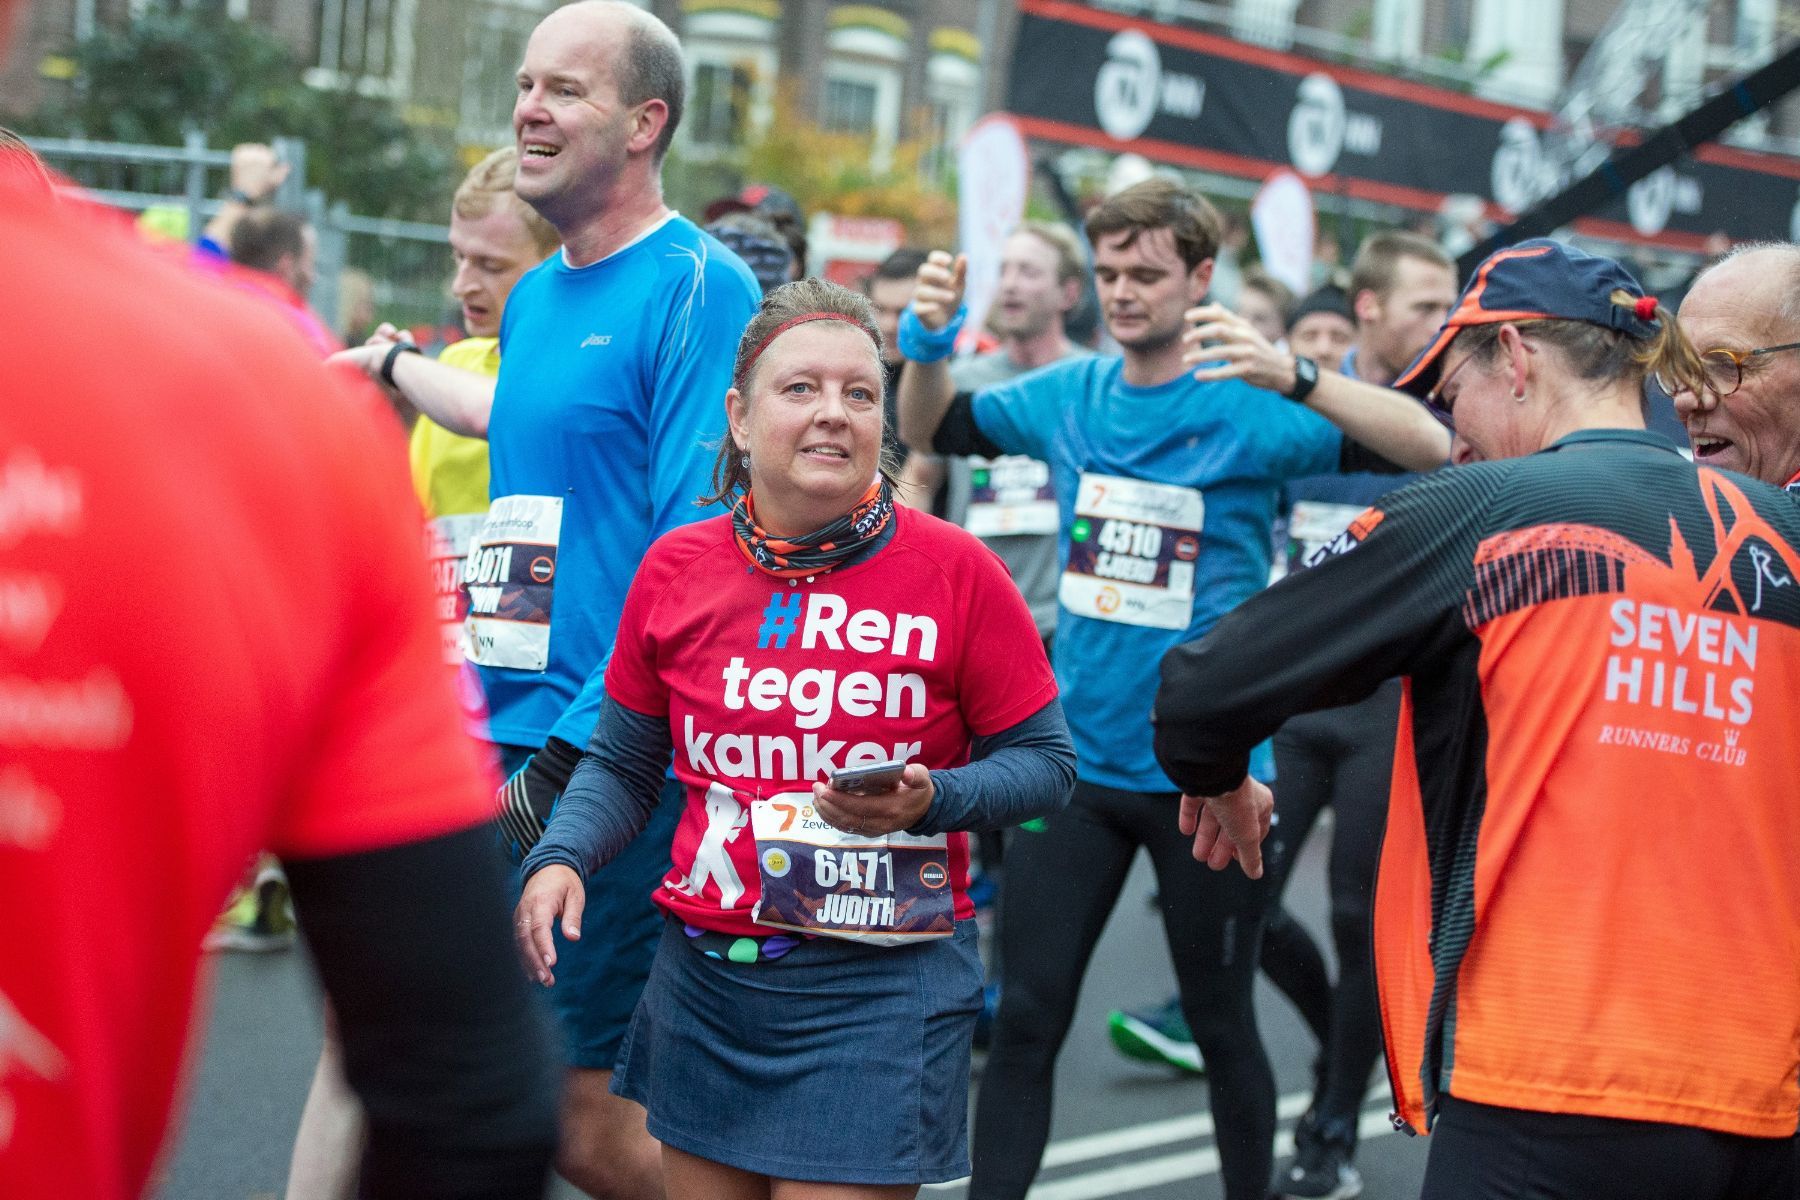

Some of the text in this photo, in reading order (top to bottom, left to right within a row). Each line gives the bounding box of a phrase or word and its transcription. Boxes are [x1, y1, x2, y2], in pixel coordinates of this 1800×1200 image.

[1097, 518, 1163, 559] 4310
[757, 592, 938, 662] #Ren
[1610, 598, 1758, 672] SEVEN
[722, 657, 926, 729] tegen
[1605, 655, 1754, 725] HILLS
[1599, 725, 1747, 767] RUNNERS CLUB
[772, 803, 797, 832] 7
[814, 849, 895, 891] 6471
[816, 894, 896, 926] JUDITH
